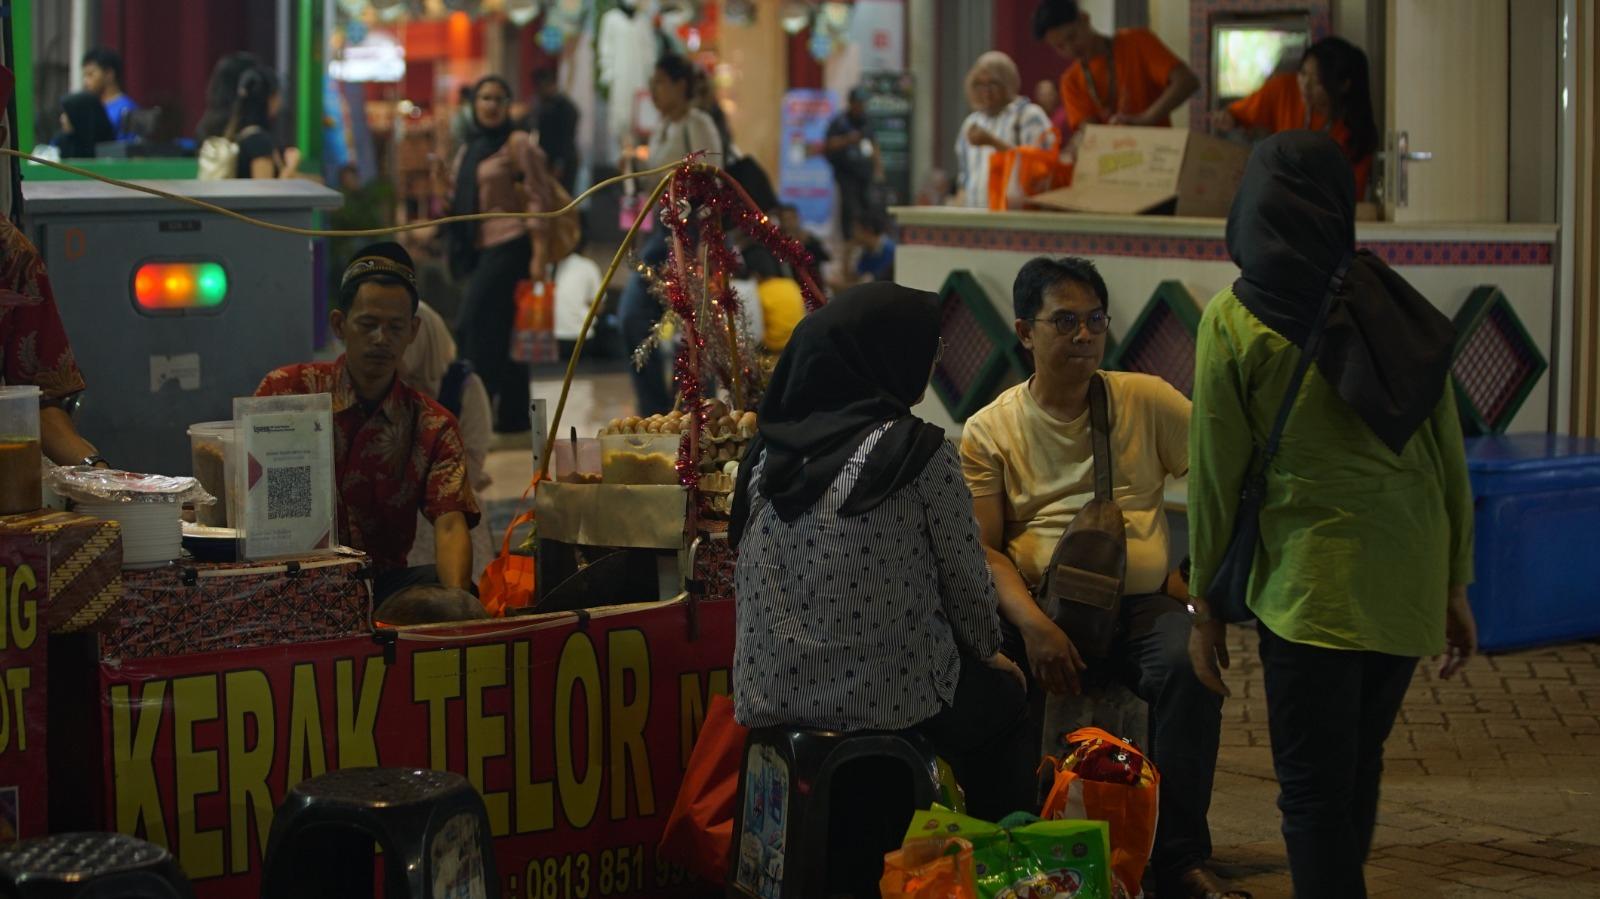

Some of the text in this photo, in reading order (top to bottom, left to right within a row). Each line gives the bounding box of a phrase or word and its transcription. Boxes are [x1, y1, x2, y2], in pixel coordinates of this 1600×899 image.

[0, 563, 38, 650] G
[111, 655, 387, 880] KERAK
[413, 629, 656, 838] TELOR
[526, 851, 592, 899] 0813
[599, 843, 645, 897] 851
